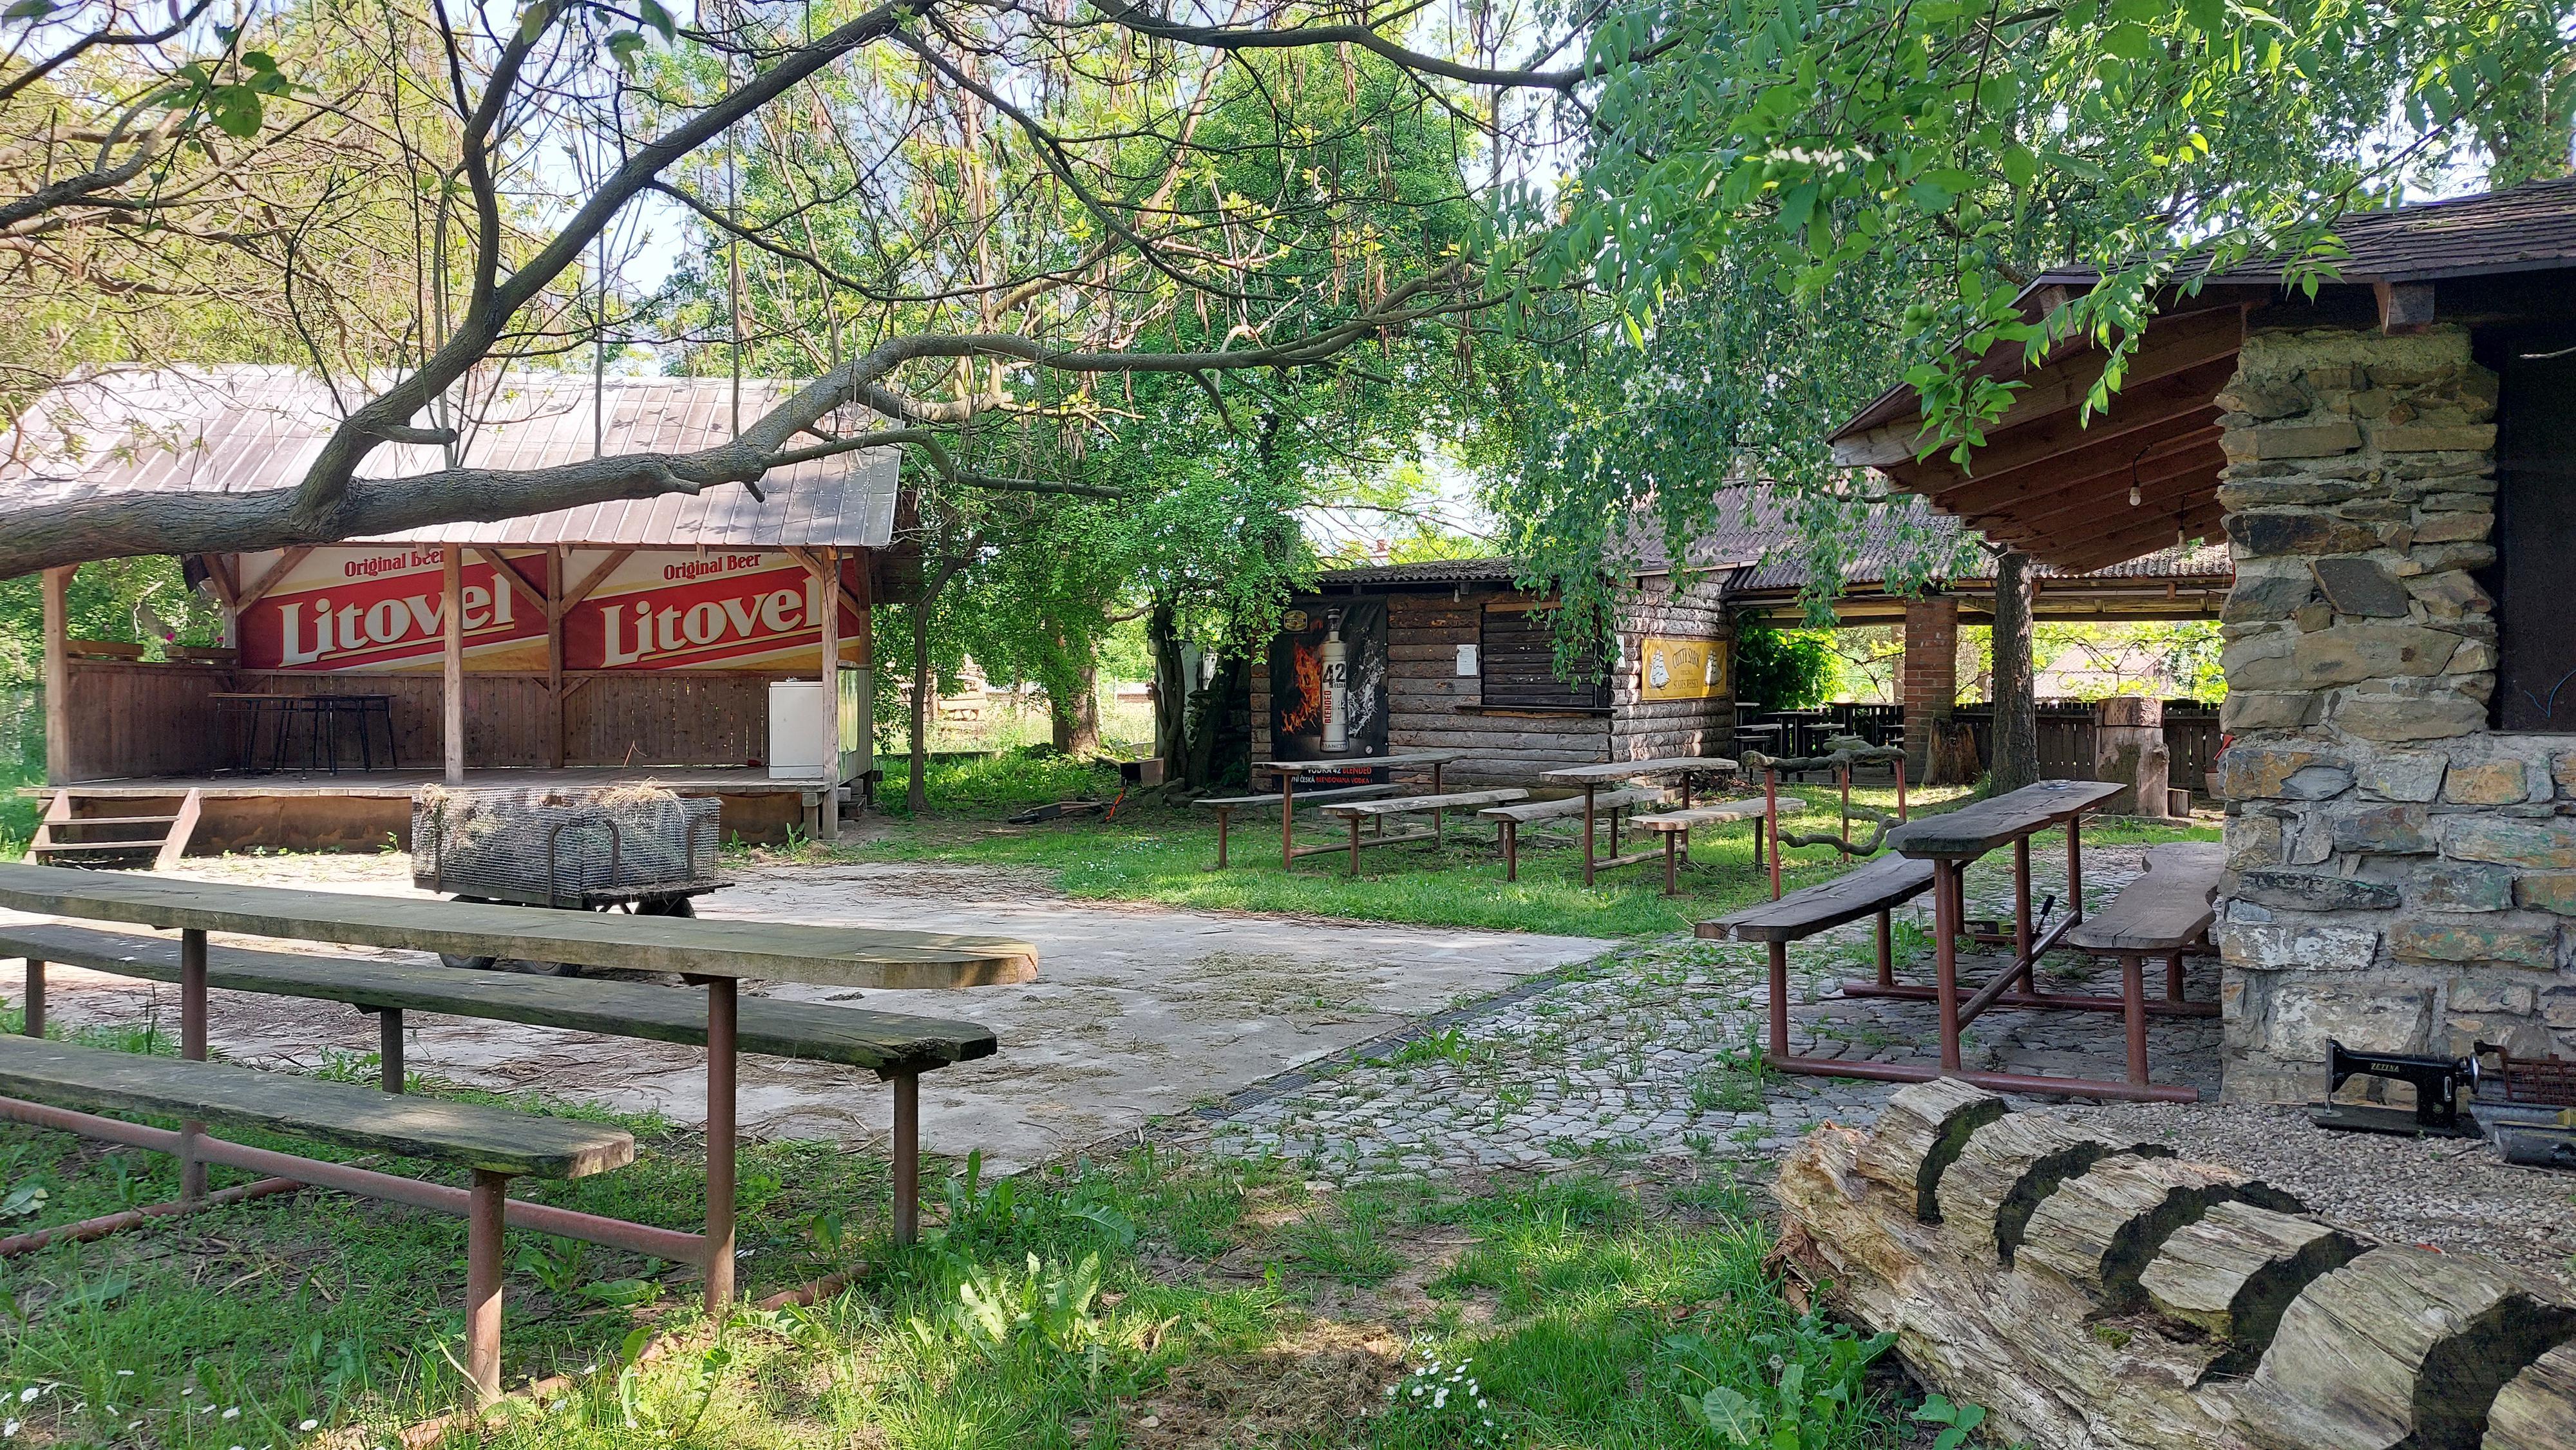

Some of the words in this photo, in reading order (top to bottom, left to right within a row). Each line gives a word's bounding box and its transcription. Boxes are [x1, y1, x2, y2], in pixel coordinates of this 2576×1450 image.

[345, 553, 406, 577] Original
[663, 557, 723, 579] Original
[727, 554, 761, 570] Beer
[278, 572, 515, 668] Litovel
[600, 577, 822, 668] Litovel
[1323, 663, 1346, 688] 42
[1300, 775, 1315, 783] ČESKÁ
[2371, 1062, 2400, 1073] ZETINA
